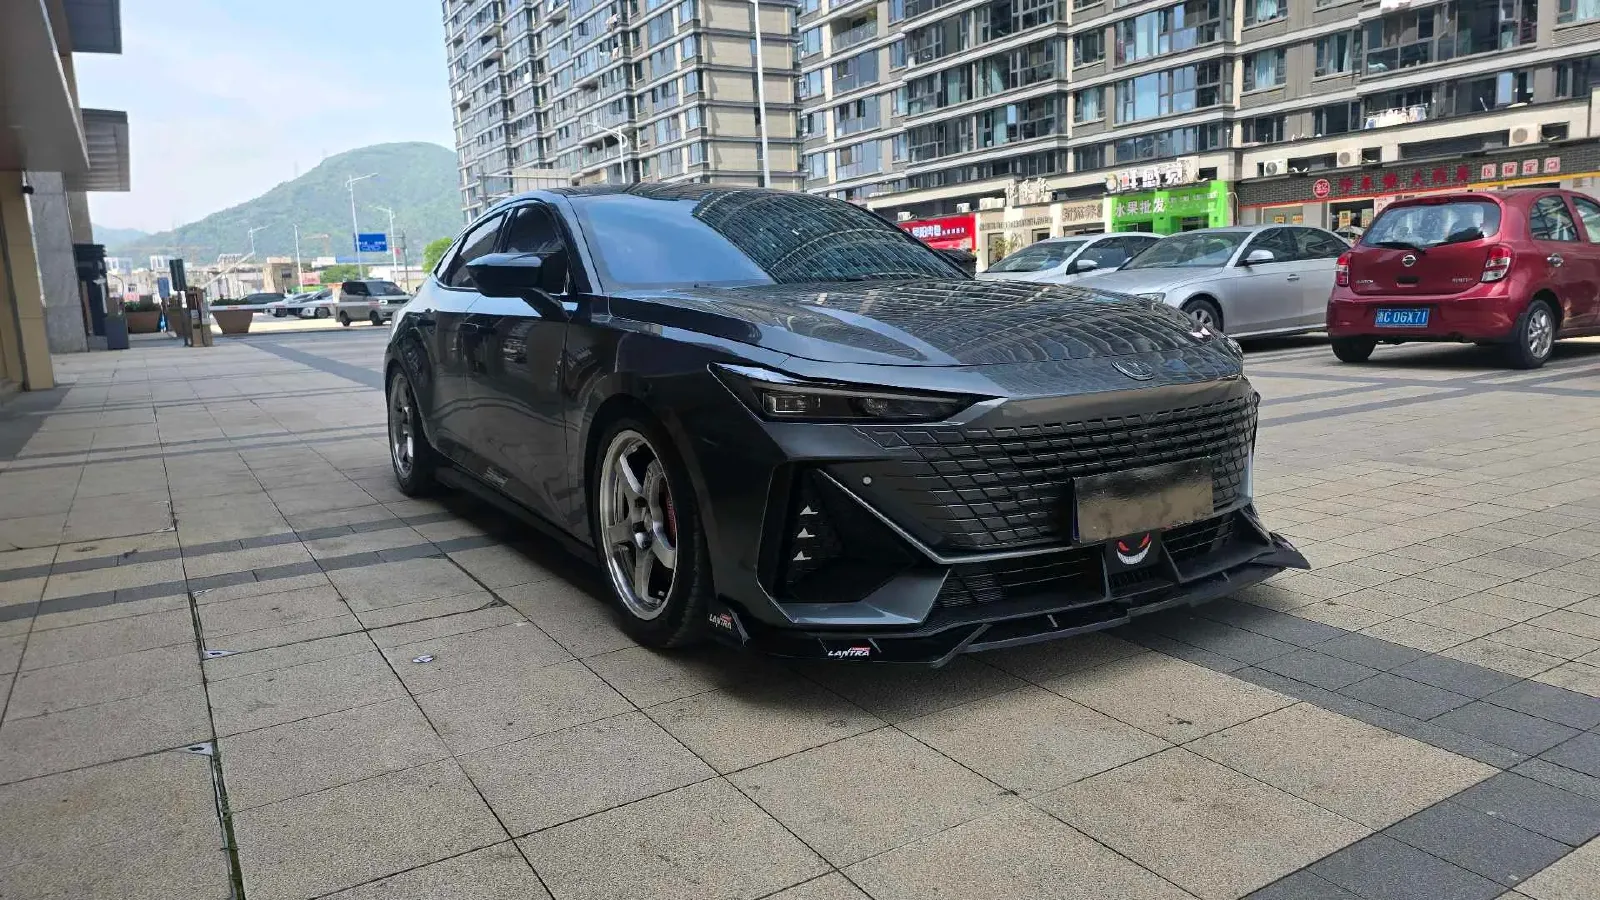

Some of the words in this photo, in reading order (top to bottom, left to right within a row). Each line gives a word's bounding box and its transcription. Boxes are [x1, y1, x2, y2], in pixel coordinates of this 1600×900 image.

[1116, 197, 1166, 217] 水果批发
[827, 647, 870, 659] LANTRA
